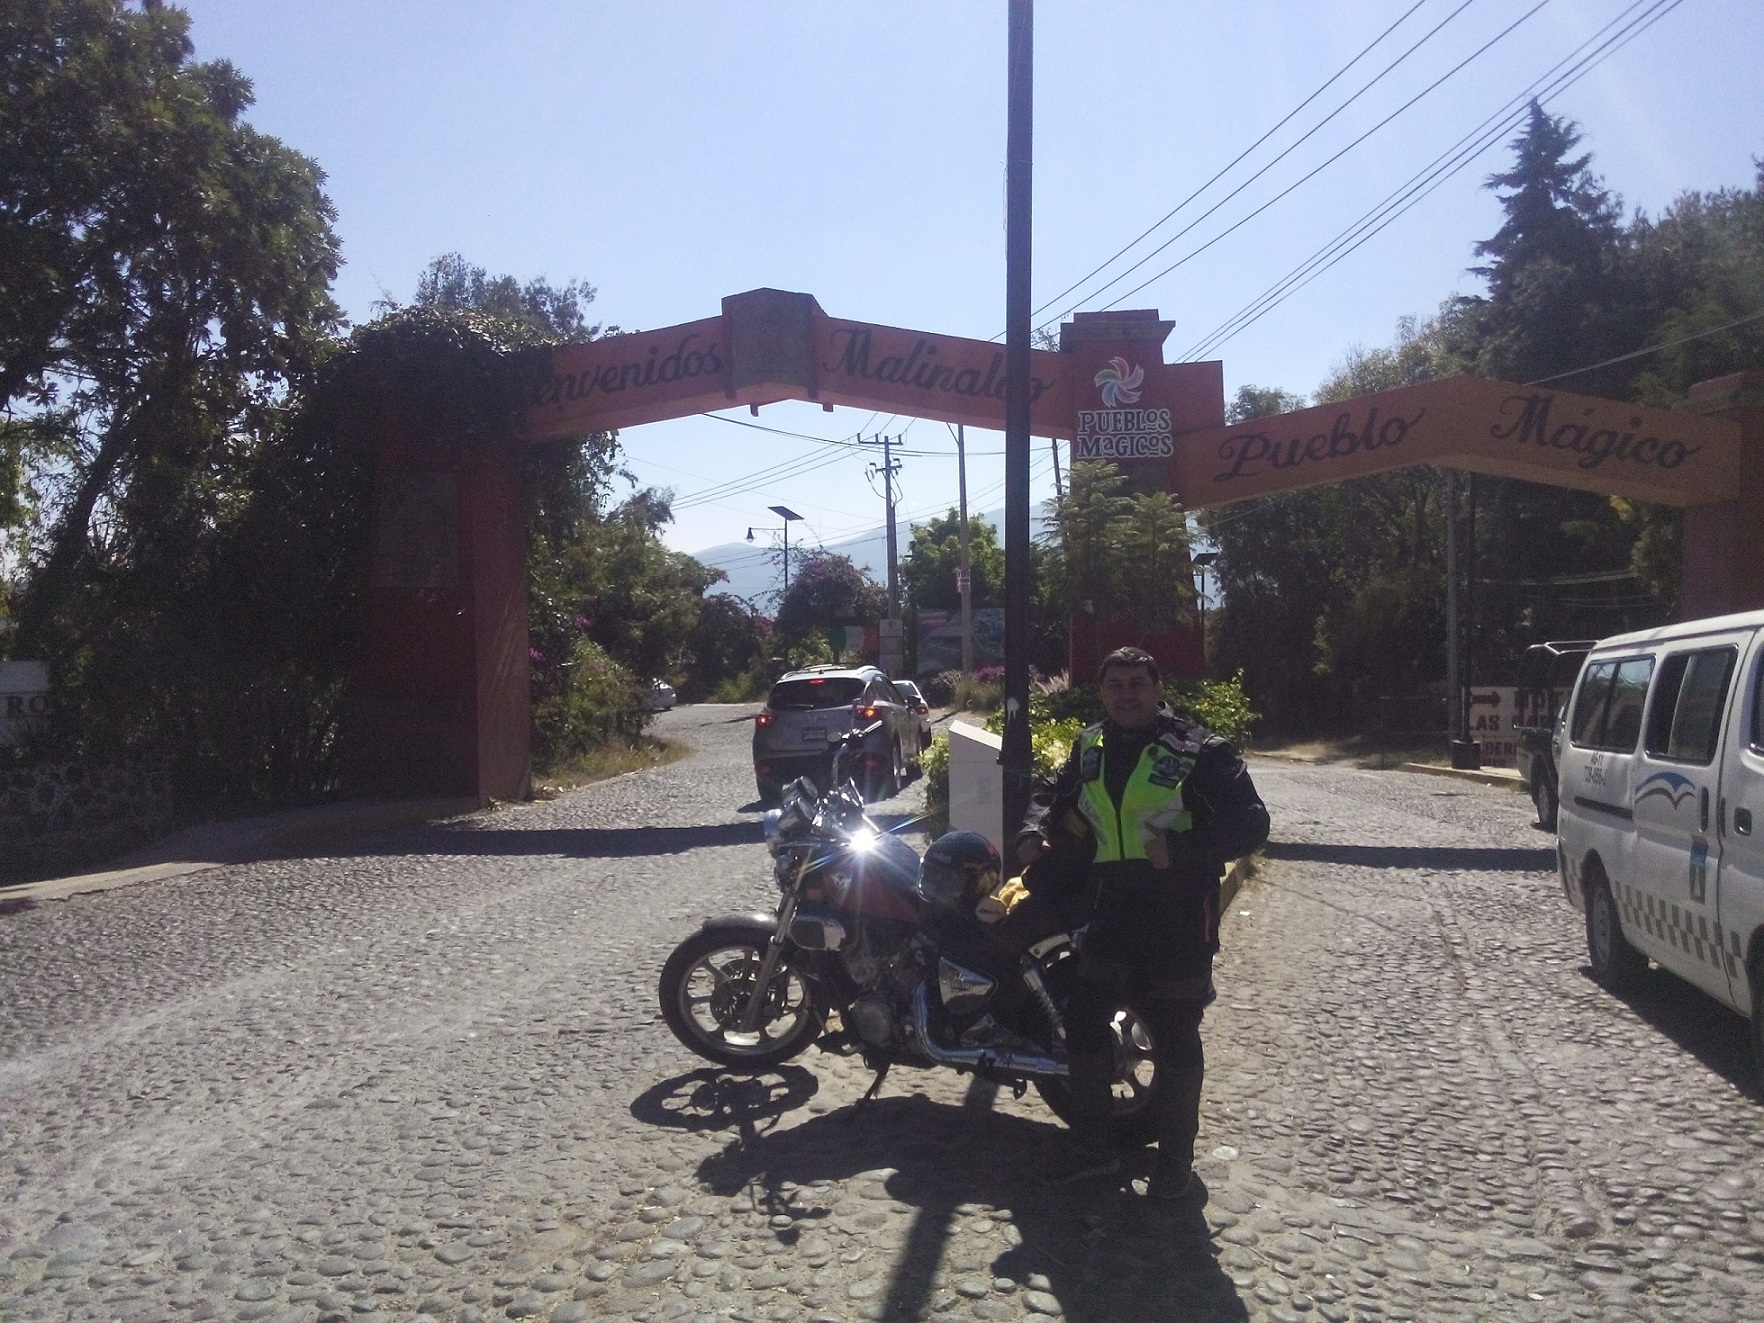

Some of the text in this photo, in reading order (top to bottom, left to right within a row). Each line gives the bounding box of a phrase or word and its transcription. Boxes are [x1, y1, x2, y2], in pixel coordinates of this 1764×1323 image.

[822, 328, 1057, 403] Malinalo
[1078, 409, 1171, 434] PUEBLOS
[1213, 394, 1702, 483] Pueblo Mágico
